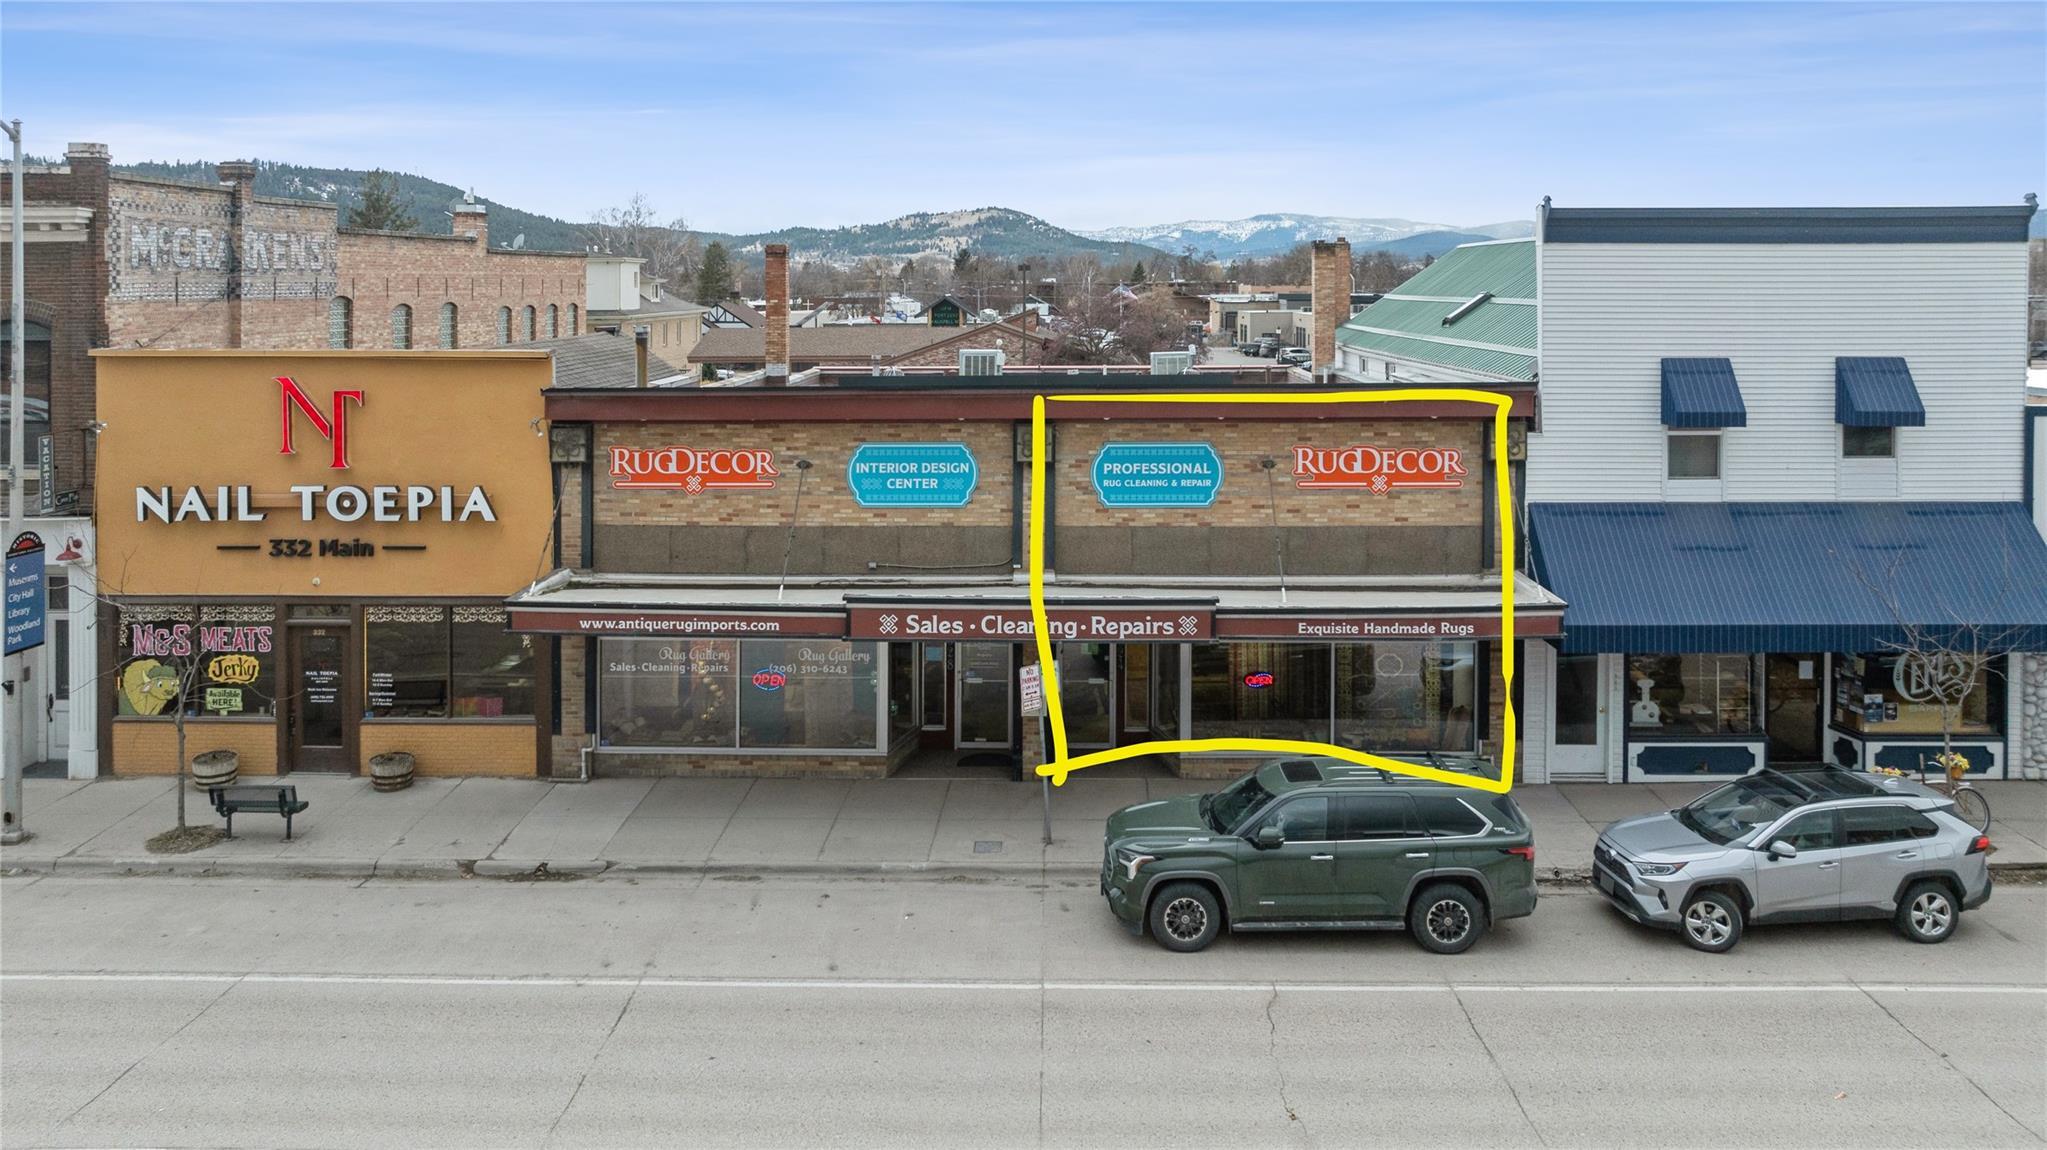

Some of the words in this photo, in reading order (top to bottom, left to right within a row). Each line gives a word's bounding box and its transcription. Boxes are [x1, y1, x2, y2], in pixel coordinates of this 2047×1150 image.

[42, 438, 51, 506] VACATION
[856, 462, 918, 475] INTERIOR
[921, 462, 970, 474] DESIGN
[1103, 462, 1212, 475] PROFESSIONAL
[886, 477, 938, 489] CENTER
[1103, 479, 1122, 488] RUG
[1124, 479, 1169, 488] CLEANING
[1171, 479, 1178, 488] &
[1180, 479, 1212, 488] REPAIR
[136, 485, 268, 523] NAIL
[290, 485, 498, 522] TOEPIA
[268, 538, 312, 557] 332
[319, 539, 375, 557] Main
[8, 573, 39, 587] Museums
[8, 593, 21, 603] City
[22, 588, 35, 600] Hall
[8, 606, 31, 619] Library
[8, 617, 41, 634] Woodland
[580, 617, 780, 632] www.antiquerugimports.com
[906, 614, 963, 634] Sales
[1091, 615, 1174, 640] Repairs
[1298, 622, 1359, 636] Exquisite
[1364, 622, 1436, 635] Handmade
[1441, 622, 1475, 636] Rugs
[7, 633, 22, 646] Park
[200, 626, 273, 652] MEATS
[659, 646, 687, 662] Rug
[689, 646, 730, 662] Gallery
[798, 647, 827, 662] Rug
[828, 647, 871, 663] Gallery
[212, 656, 257, 680] Jerky
[610, 662, 636, 672] Sales
[641, 662, 686, 674] Cleaning
[769, 663, 797, 674] (206)
[800, 663, 848, 674] 310-6243
[752, 674, 786, 687] OPEN
[1246, 674, 1273, 686] OPEN
